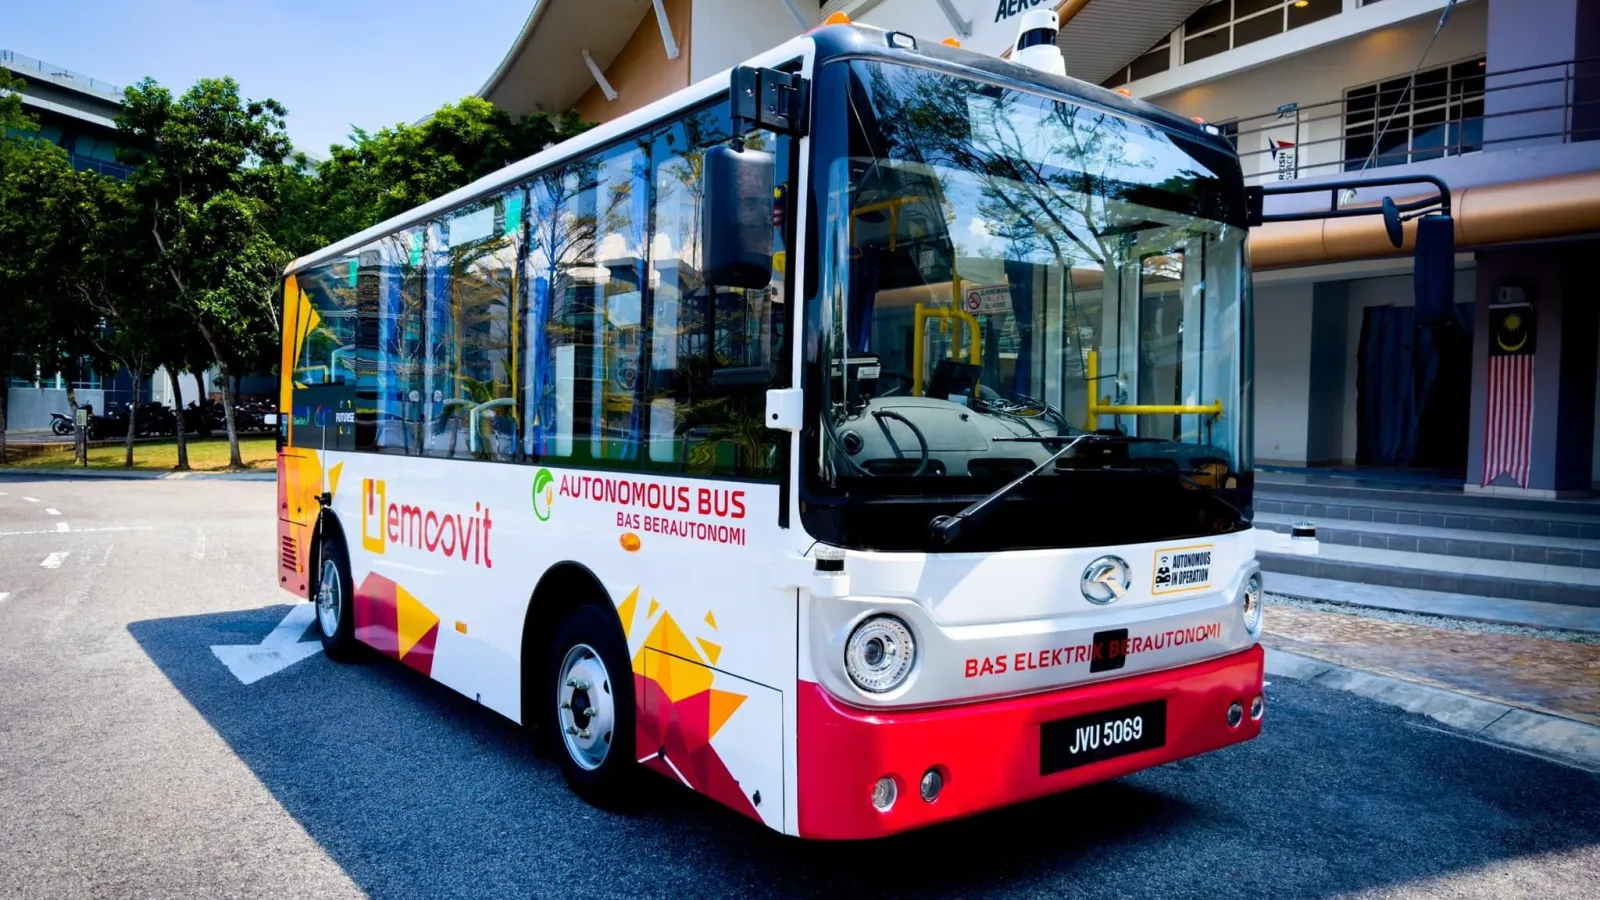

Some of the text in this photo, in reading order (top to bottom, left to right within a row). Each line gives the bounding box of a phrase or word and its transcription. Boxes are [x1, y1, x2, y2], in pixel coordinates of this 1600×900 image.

[559, 474, 747, 519] AUTONOMOUS BUS
[616, 511, 746, 546] BAS BERAUTONOMI
[1171, 568, 1209, 586] IN OPERATION
[1172, 551, 1212, 569] AUTONOMOUS
[964, 622, 1222, 679] BAS ELEKTRIK BERAUTONOMI
[1069, 715, 1143, 755] JVU 5069
